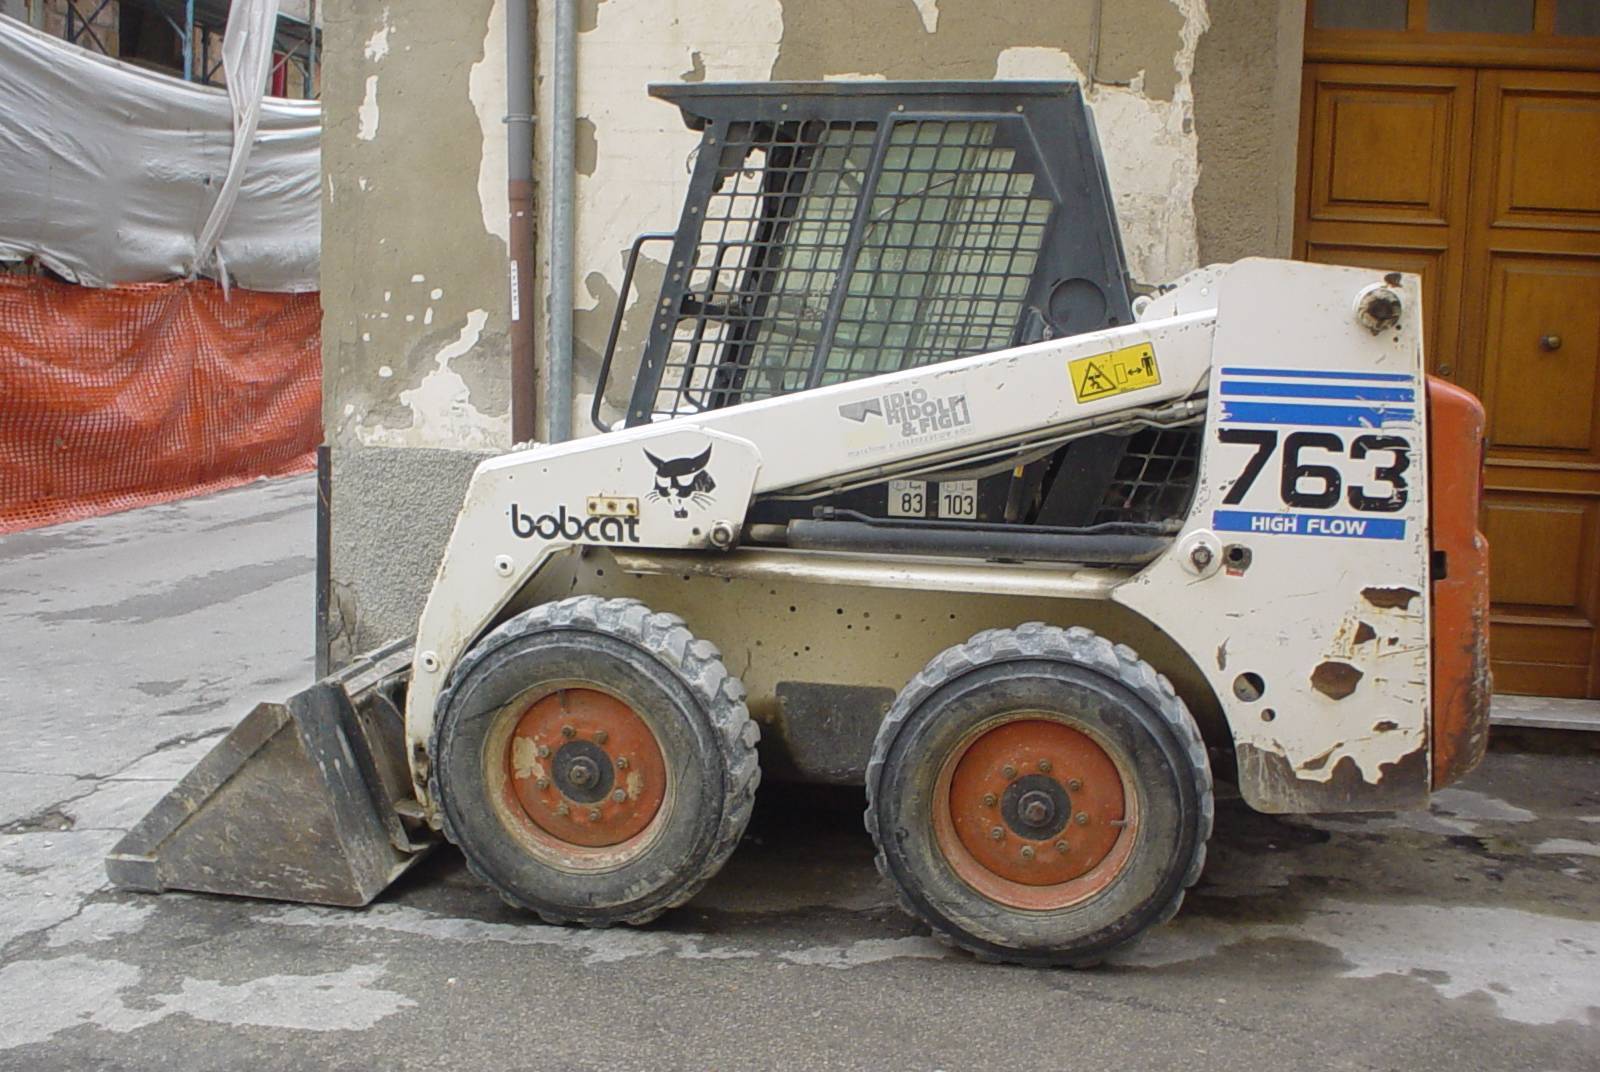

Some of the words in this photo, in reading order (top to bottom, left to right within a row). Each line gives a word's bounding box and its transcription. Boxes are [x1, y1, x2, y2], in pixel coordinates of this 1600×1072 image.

[902, 422, 917, 437] &
[919, 408, 970, 434] FIGLI
[1218, 428, 1411, 512] 763
[902, 493, 923, 513] 83
[944, 495, 974, 515] 103
[511, 504, 640, 543] bobcat
[1251, 516, 1298, 533] HIGH
[1307, 518, 1367, 536] FLOW
